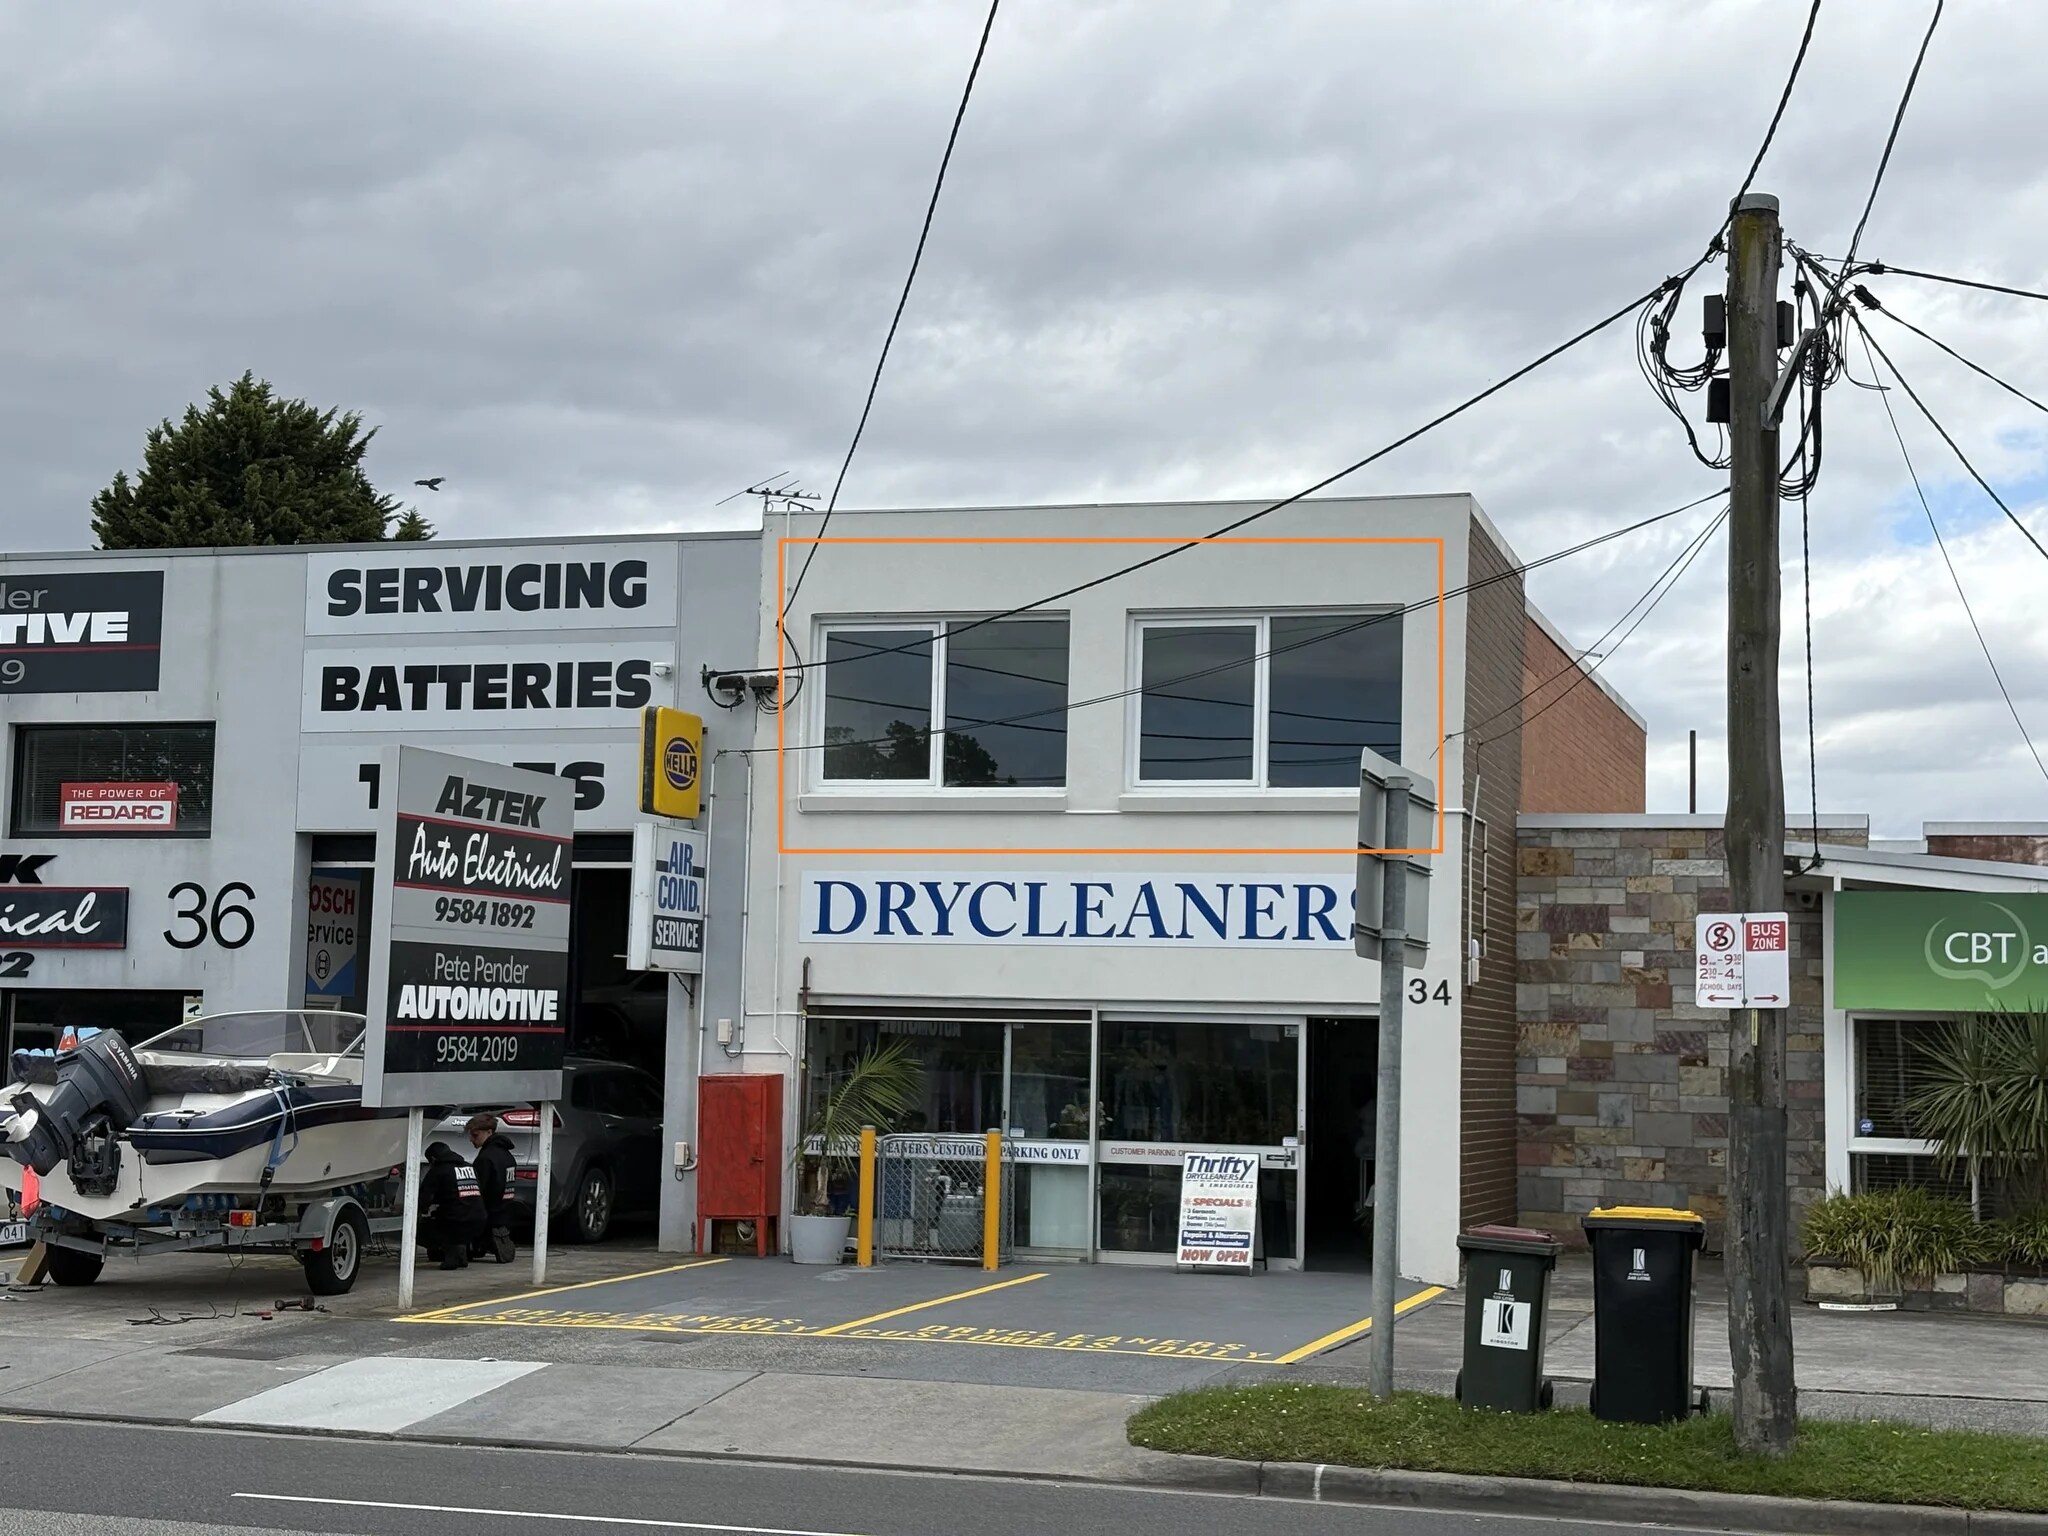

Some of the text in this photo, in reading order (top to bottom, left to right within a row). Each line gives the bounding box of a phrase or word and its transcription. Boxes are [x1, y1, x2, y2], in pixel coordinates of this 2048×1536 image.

[327, 560, 648, 617] SERVICING
[1, 659, 25, 685] 9
[320, 660, 652, 711] BATTERIES
[665, 751, 698, 779] HELLA
[72, 789, 166, 798] THE POWER OF
[435, 775, 547, 829] AZTEK
[70, 805, 164, 820] REDARC
[408, 822, 563, 890] Auto Electrical
[668, 841, 693, 878] AIR
[310, 884, 356, 915] OSCH
[657, 875, 700, 913] COND.
[163, 881, 256, 949] 36
[435, 897, 536, 929] 9584 1892
[812, 880, 1355, 941] DRYCLEANER
[308, 919, 354, 945] ervice
[655, 918, 699, 949] SERVICE
[1751, 923, 1781, 936] BUS
[1752, 937, 1780, 950] ZONE
[1944, 931, 2017, 964] CBT
[434, 952, 529, 984] Pete Pender
[1408, 978, 1453, 1007] 34
[1700, 983, 1743, 991] SCHOOL DAYS
[397, 984, 559, 1021] AUTOMOTIVE
[436, 1036, 518, 1063] 9584 2019
[116, 1047, 139, 1081] YAMAHA
[1052, 1148, 1081, 1160] ONLY
[1110, 1147, 1145, 1156] CUSTOMER
[1148, 1148, 1176, 1157] PARKING
[1185, 1173, 1239, 1181] DRYCLEANERS
[1187, 1156, 1255, 1180] Thrifty
[1193, 1198, 1243, 1207] SPECIALS
[4, 1226, 24, 1240] 041
[1181, 1249, 1249, 1262] NOW OPEN
[849, 1329, 1272, 1359] CUSTOMERS ONLY
[917, 1325, 1247, 1350] DRYCLEANERS
